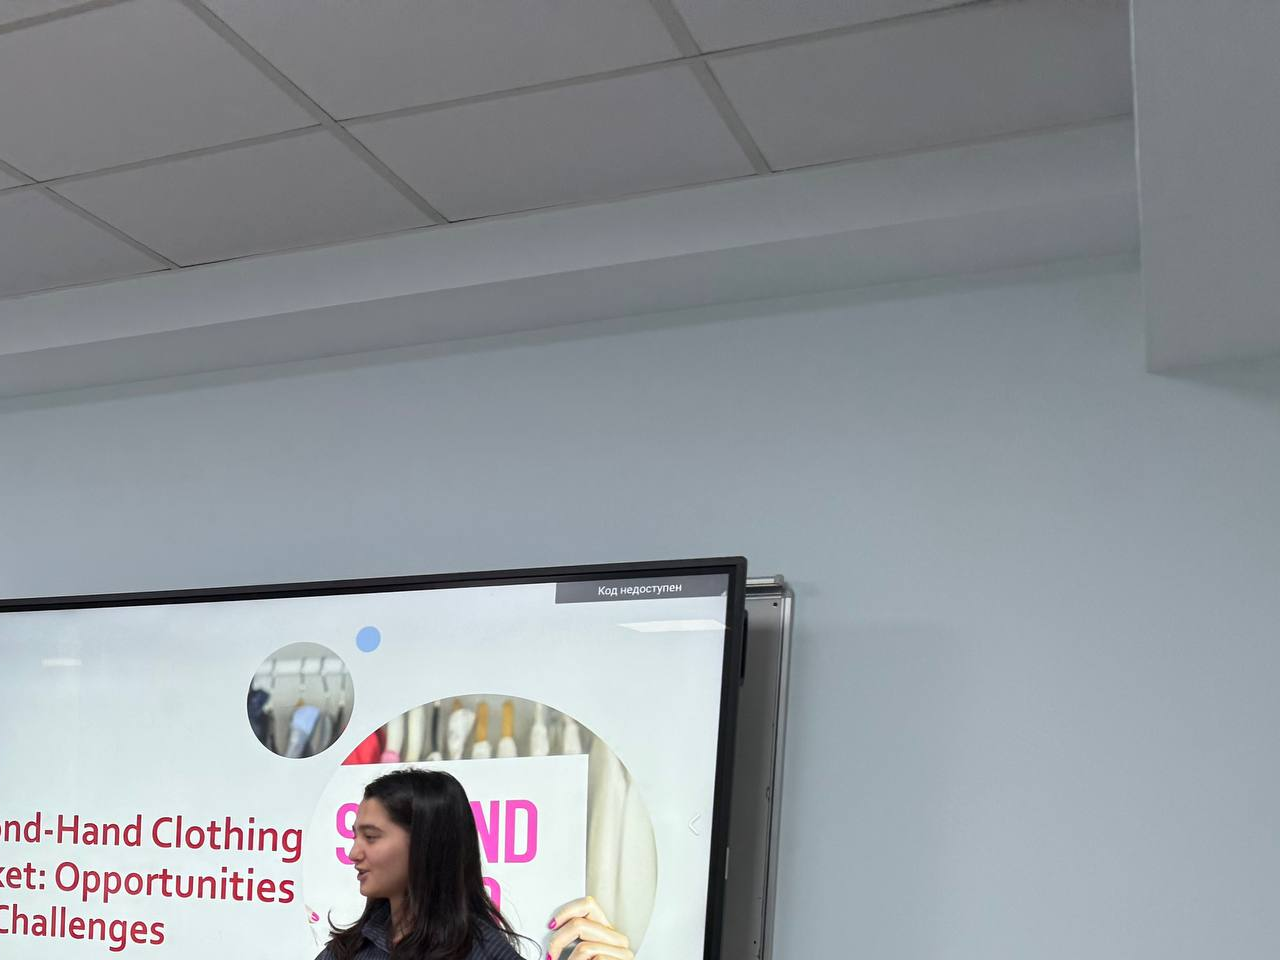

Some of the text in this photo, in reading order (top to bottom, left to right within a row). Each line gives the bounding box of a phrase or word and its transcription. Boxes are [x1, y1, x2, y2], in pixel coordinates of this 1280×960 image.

[598, 584, 682, 597] Код недоступен
[152, 815, 302, 863] Clothing
[335, 799, 538, 865] SND
[55, 861, 295, 903] Opportunities
